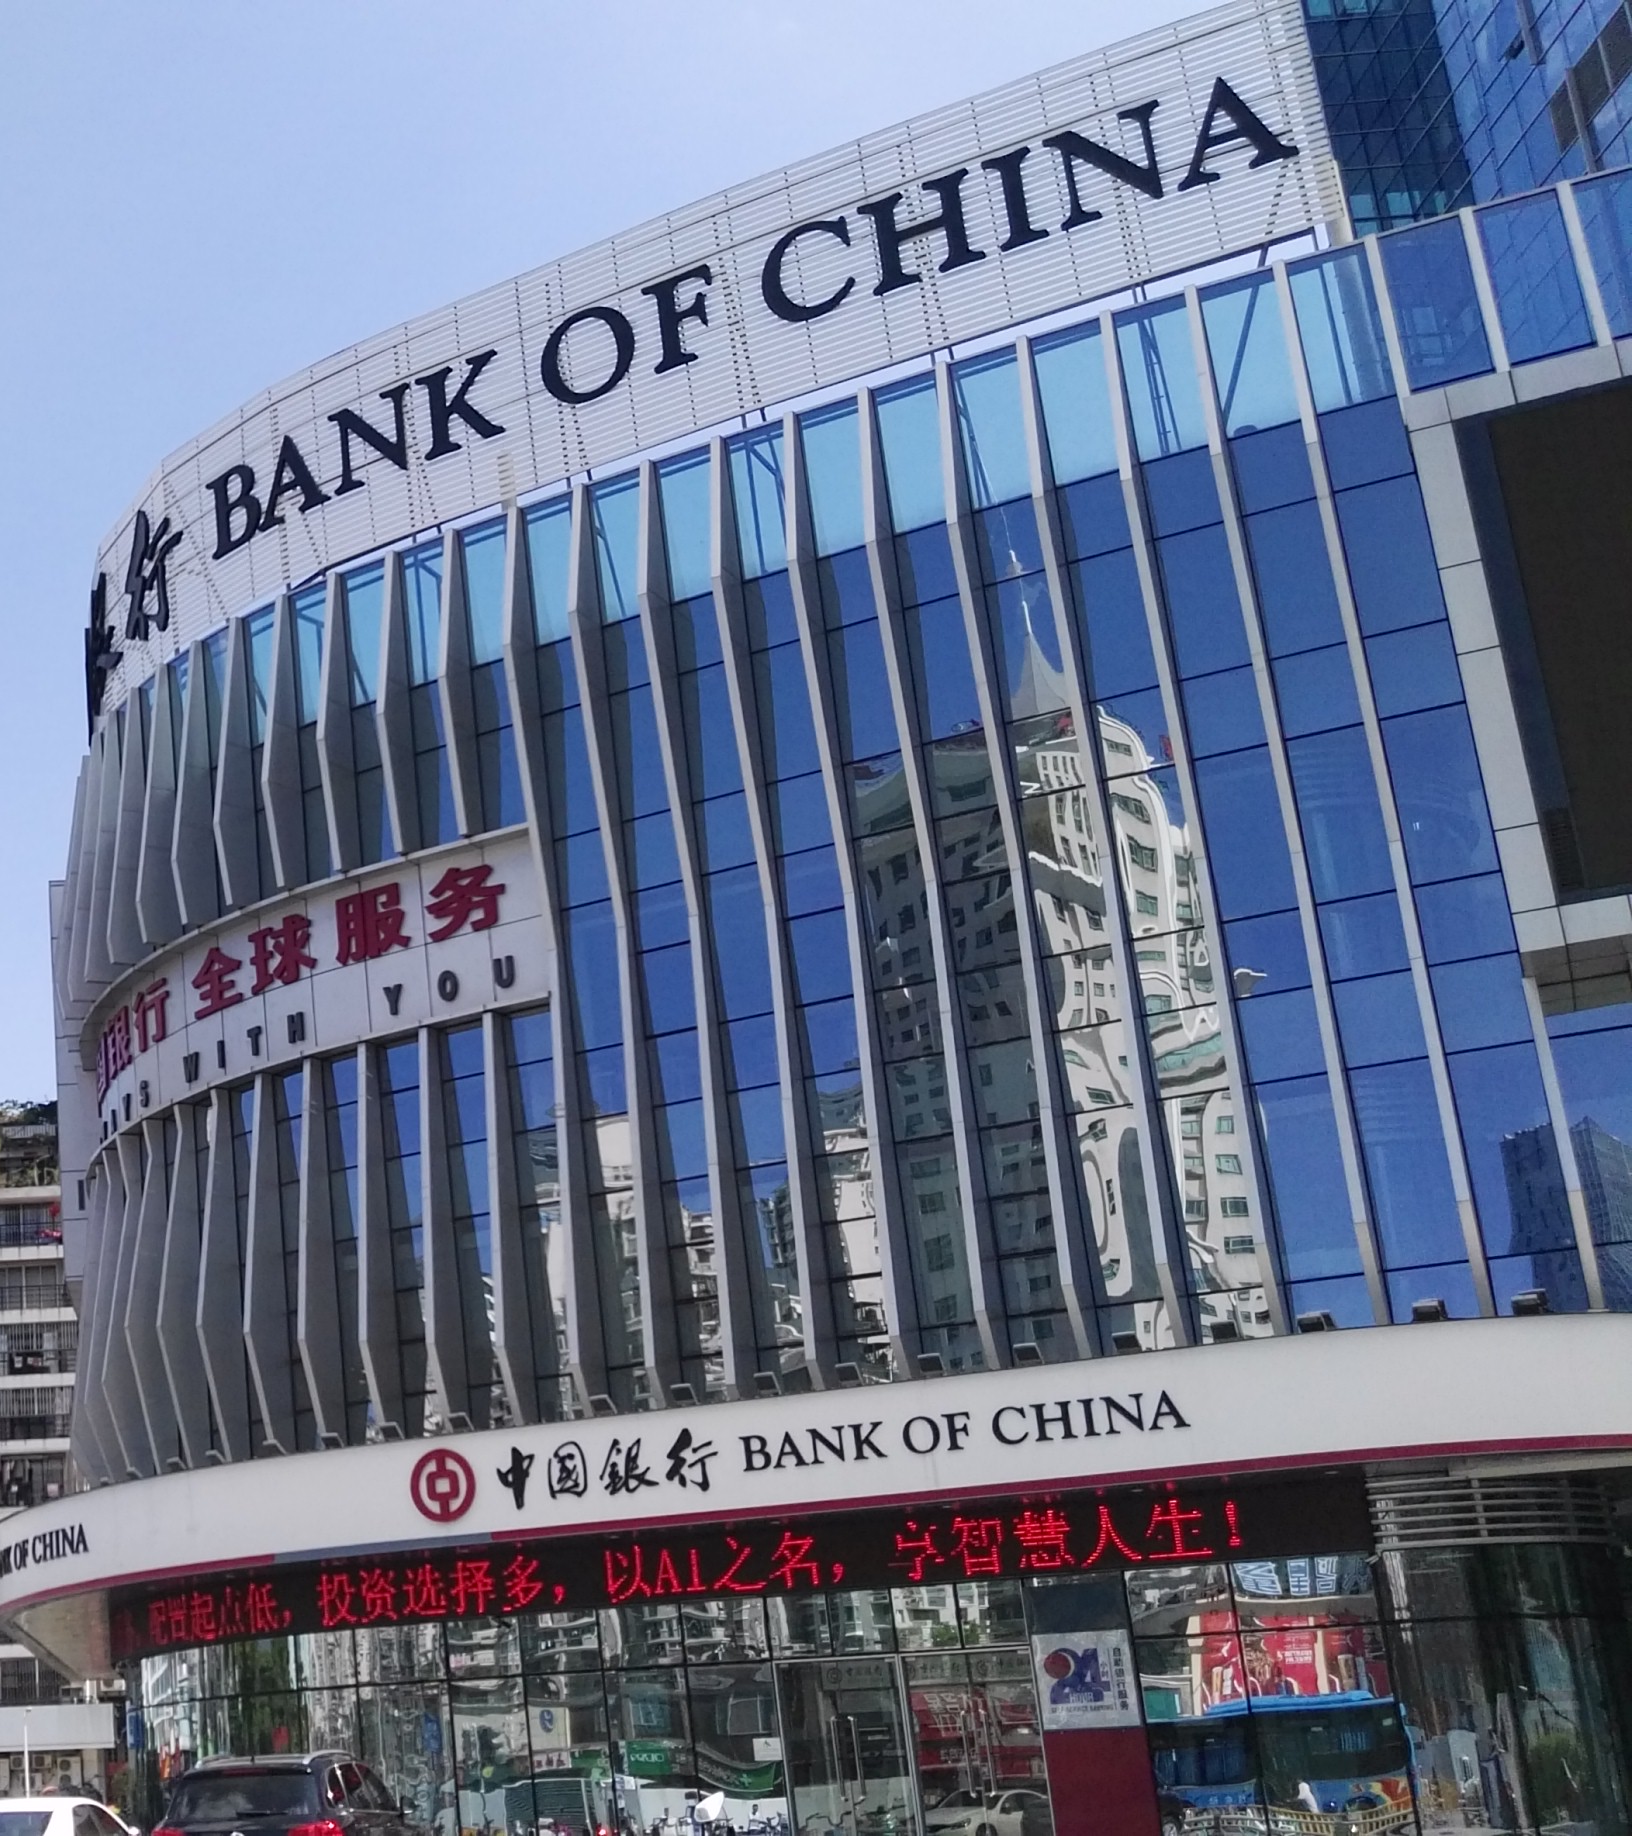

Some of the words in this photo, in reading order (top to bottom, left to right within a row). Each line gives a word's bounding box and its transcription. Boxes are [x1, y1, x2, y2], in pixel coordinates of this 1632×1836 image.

[206, 350, 505, 561] BANK
[540, 263, 711, 404] OF
[761, 76, 1299, 323] CHINA
[191, 864, 506, 1021] 全球服务
[183, 1011, 305, 1085] WITH
[382, 955, 515, 1016] YOU
[739, 1421, 888, 1473] BANK
[902, 1411, 971, 1455] OF
[992, 1390, 1191, 1446] CHINA
[14, 1539, 29, 1571] OF
[31, 1523, 89, 1564] CHINA
